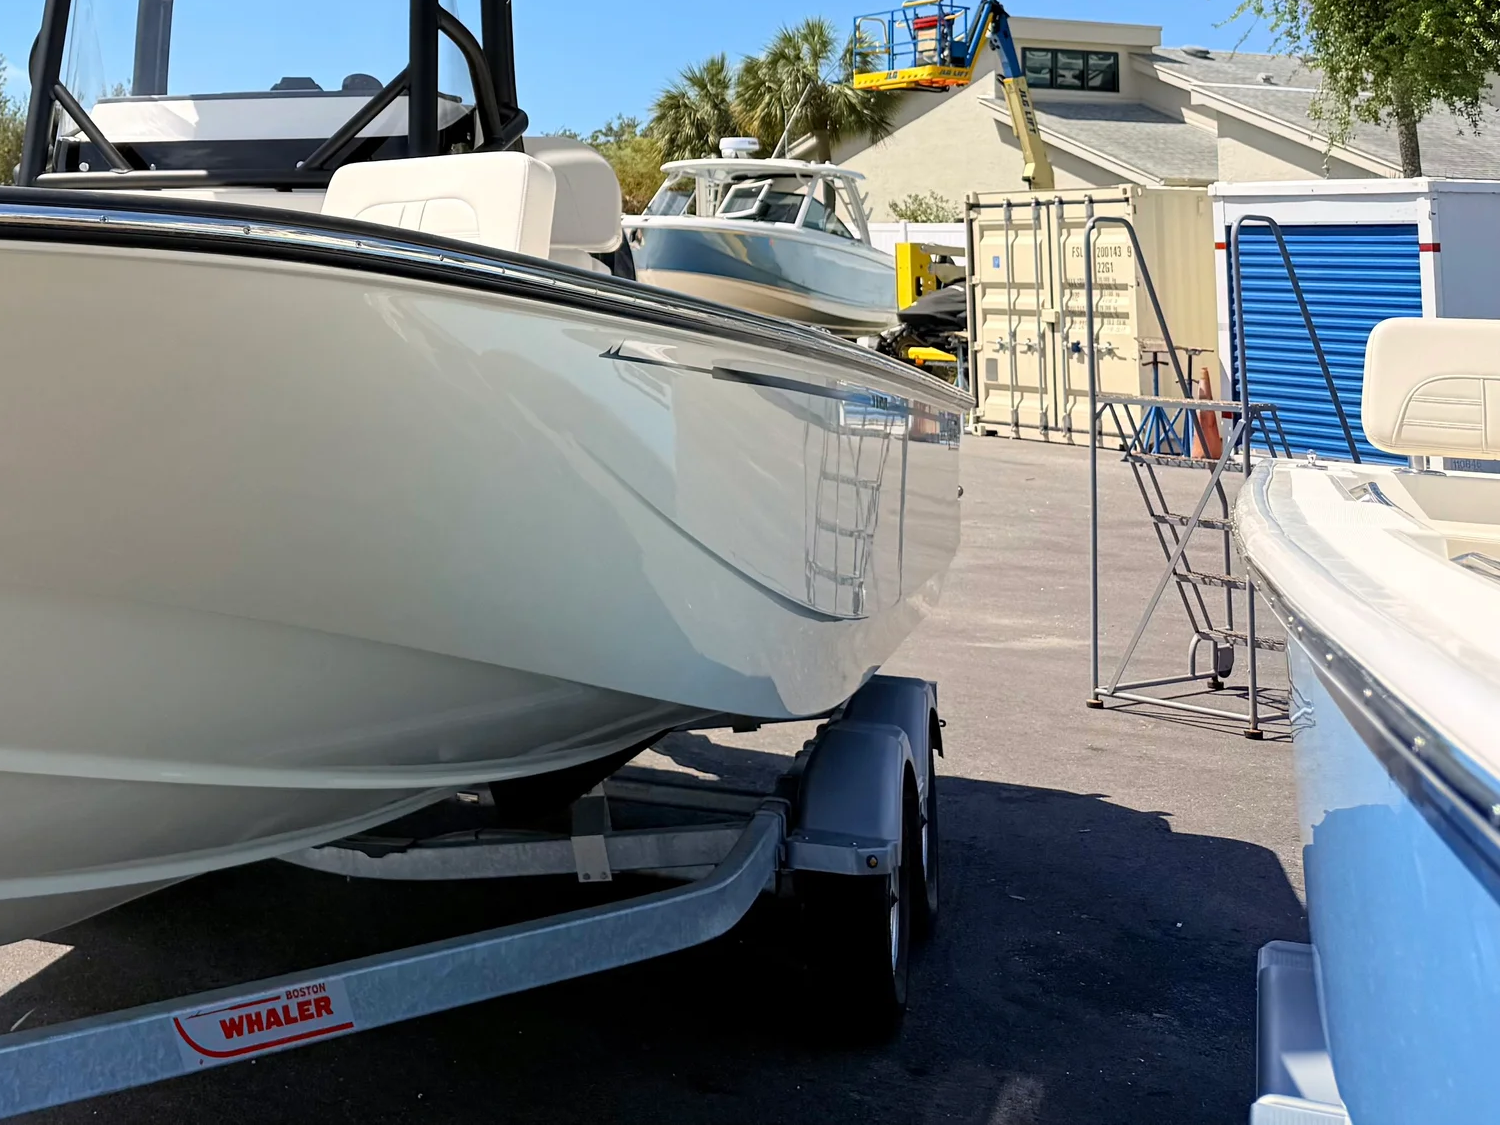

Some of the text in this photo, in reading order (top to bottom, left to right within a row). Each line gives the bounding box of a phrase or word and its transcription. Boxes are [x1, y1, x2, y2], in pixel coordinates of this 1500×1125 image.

[1019, 88, 1036, 134] JLG LIFT
[1096, 246, 1122, 258] 200143
[1097, 262, 1114, 273] 22G1
[285, 983, 327, 1000] BOSTON
[219, 996, 334, 1039] WHALER
